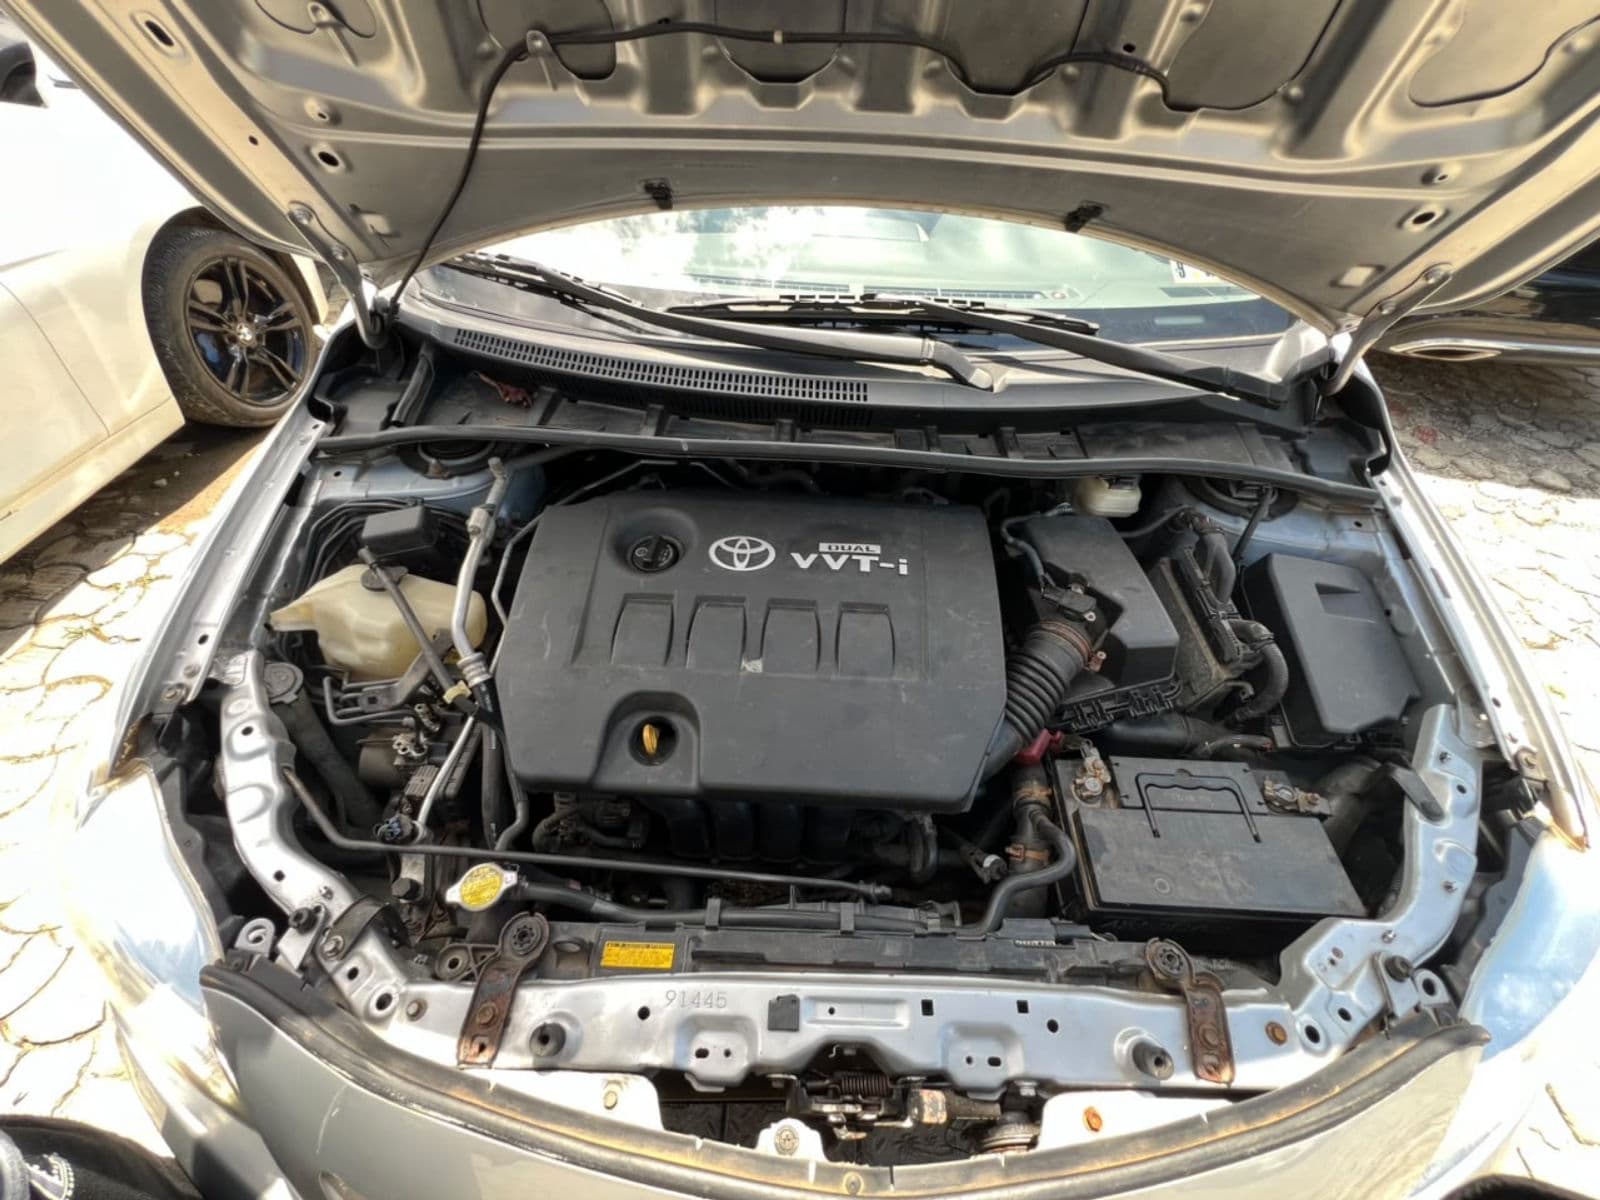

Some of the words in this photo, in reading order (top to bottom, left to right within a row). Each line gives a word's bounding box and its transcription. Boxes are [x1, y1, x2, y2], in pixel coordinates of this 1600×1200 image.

[827, 544, 878, 553] DUAL
[790, 552, 909, 575] VVT-i
[664, 989, 728, 1009] 91445
